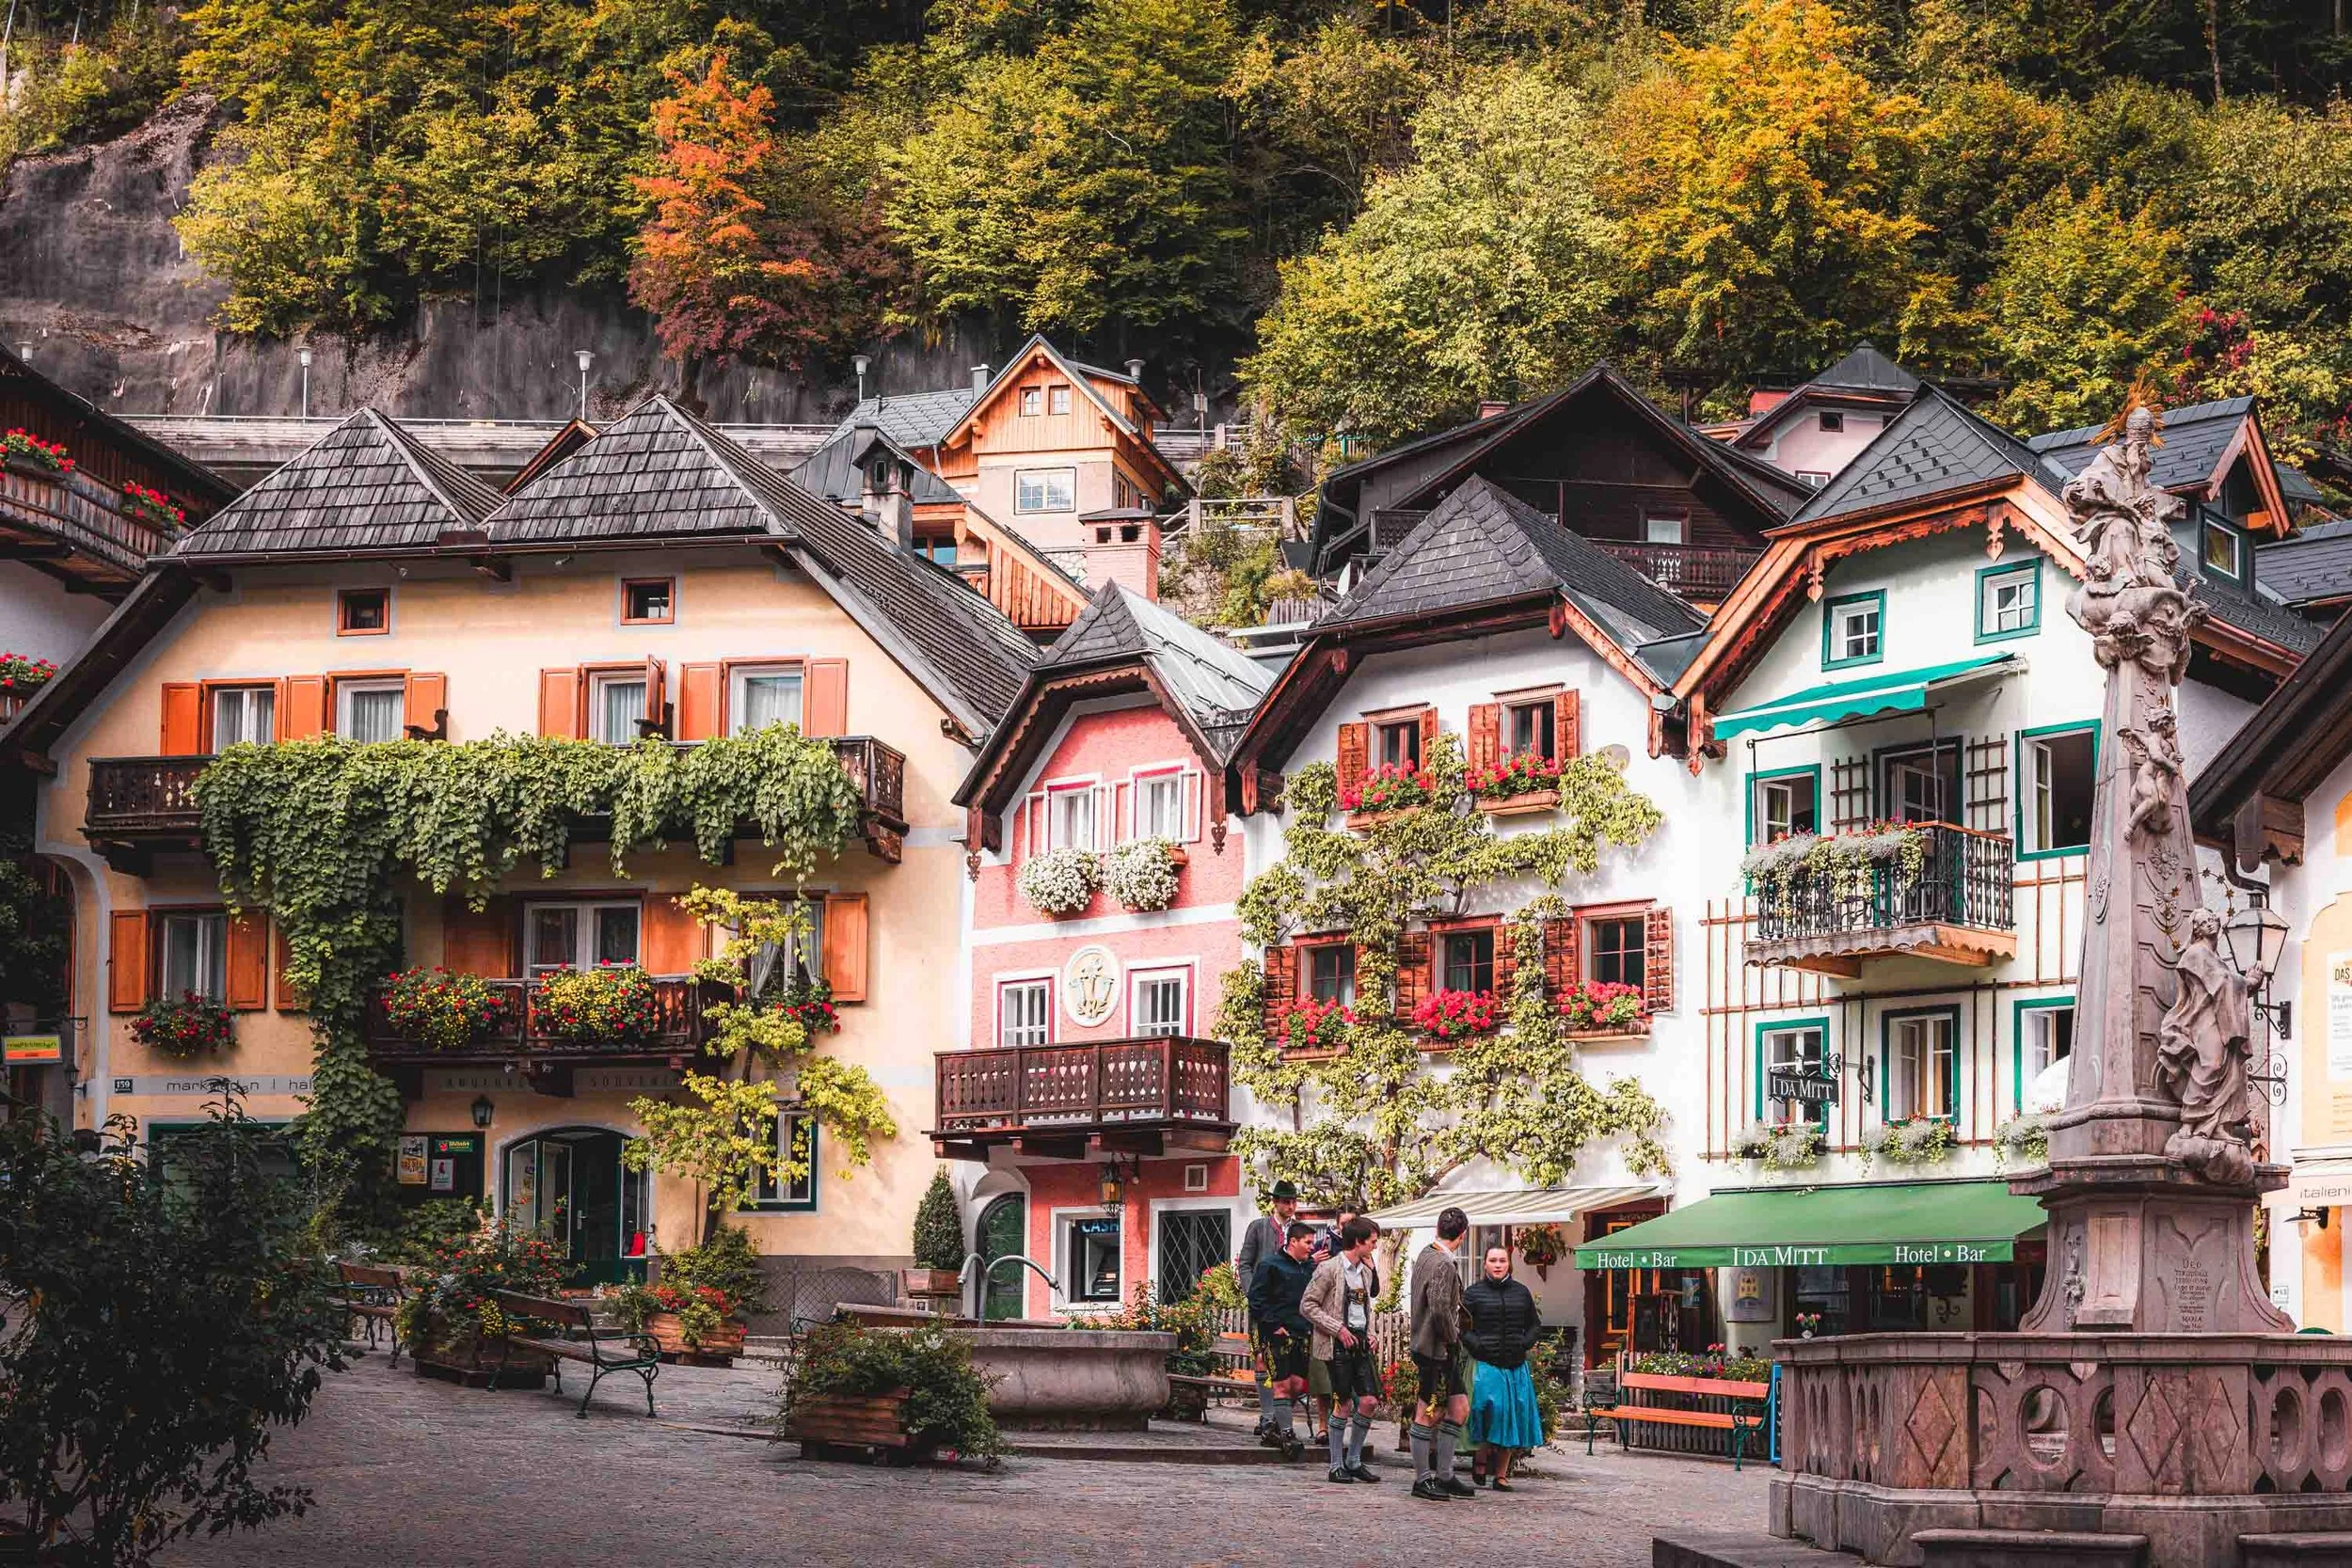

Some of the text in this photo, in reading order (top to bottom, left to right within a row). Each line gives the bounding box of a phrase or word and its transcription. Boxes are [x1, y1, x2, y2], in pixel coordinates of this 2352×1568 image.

[2334, 968, 2350, 981] DAS
[117, 1080, 131, 1088] 159
[1799, 1078, 1833, 1100] MITT
[1082, 1222, 1120, 1232] CASH
[1597, 1252, 1677, 1268] Hotel Bar
[1774, 1246, 1829, 1266] MITT
[1895, 1244, 1986, 1262] Hotel Bar
